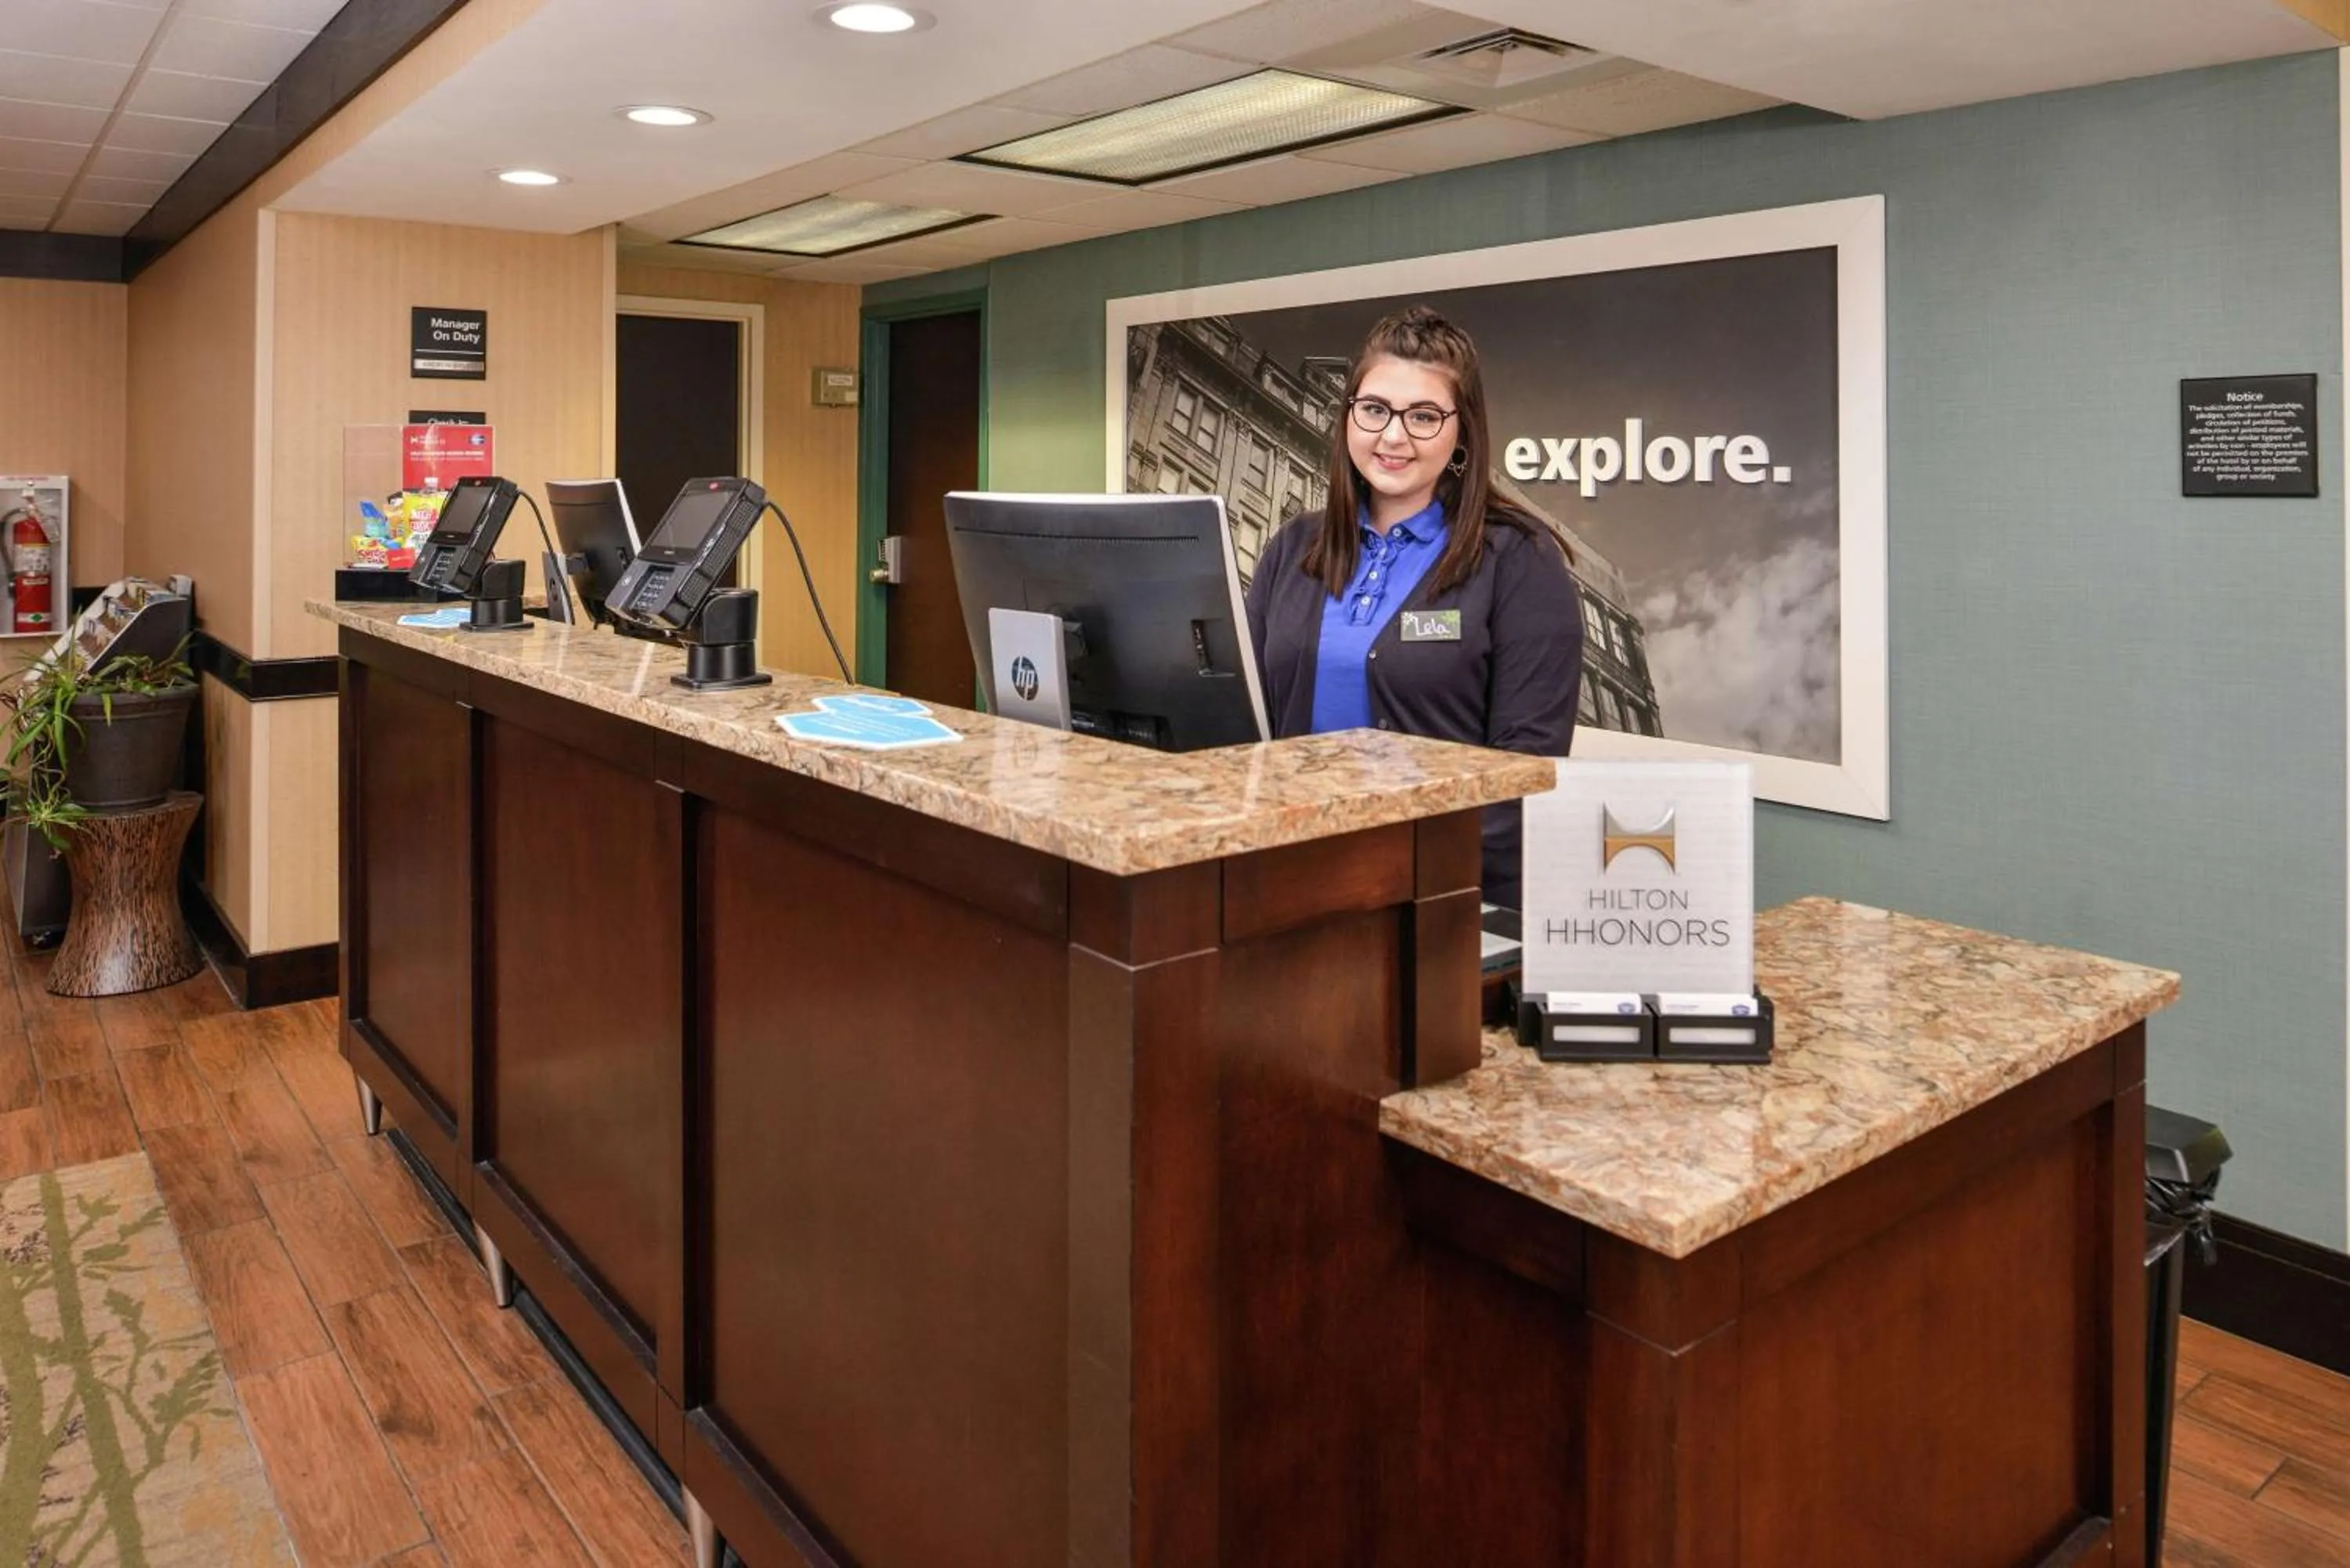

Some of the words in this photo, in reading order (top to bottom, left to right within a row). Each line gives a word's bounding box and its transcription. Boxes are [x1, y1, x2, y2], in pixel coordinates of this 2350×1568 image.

[431, 317, 480, 331] Manager
[433, 330, 450, 341] On
[453, 331, 480, 345] Duty
[2227, 392, 2264, 401] Notice
[1504, 417, 1791, 497] explore.
[1016, 656, 1035, 701] hp
[1589, 889, 1689, 910] HILTON
[1546, 918, 1731, 947] HHONORS
